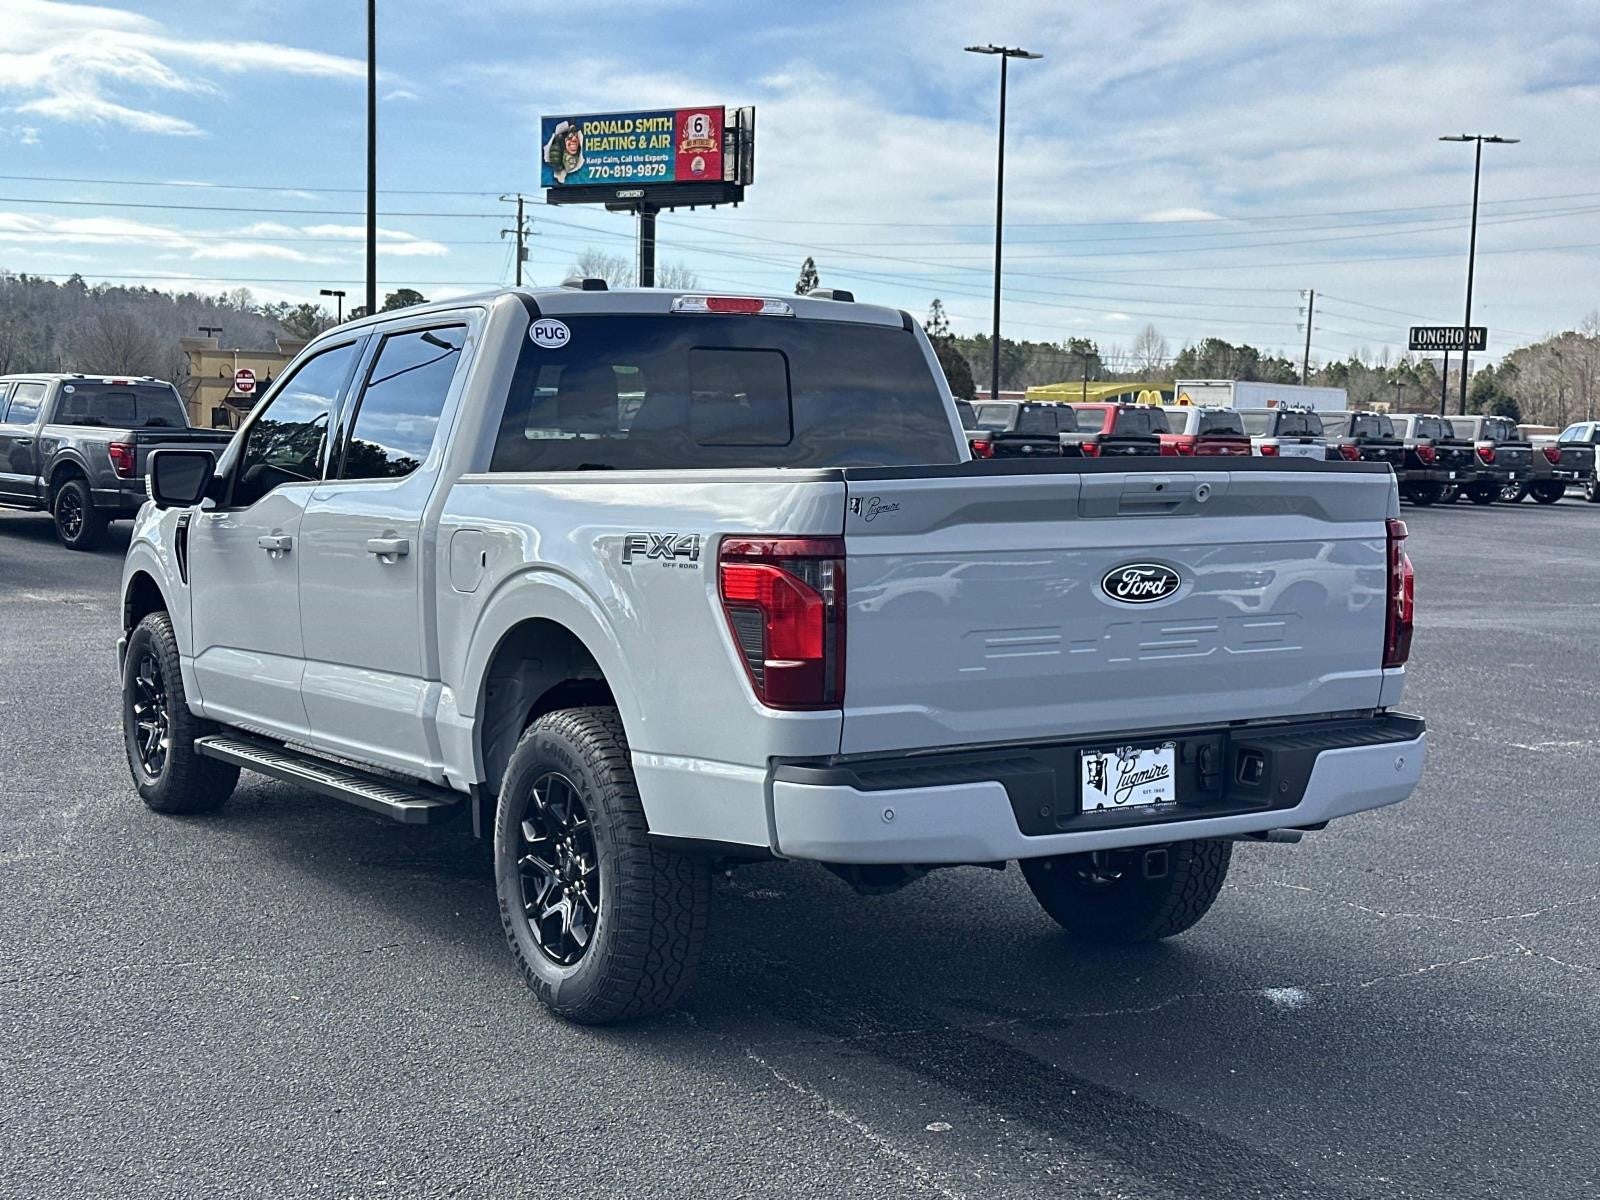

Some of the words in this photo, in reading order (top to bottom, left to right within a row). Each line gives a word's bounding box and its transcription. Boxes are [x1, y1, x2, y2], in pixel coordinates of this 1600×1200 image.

[583, 120, 634, 135] RONALD
[635, 117, 673, 133] SMITH
[694, 117, 703, 133] 6
[585, 136, 636, 151] HEATING
[638, 135, 647, 149] &
[649, 134, 671, 149] AIR
[586, 157, 602, 165] Keep
[603, 155, 620, 163] Calm,
[645, 154, 669, 162] Experts
[588, 163, 667, 179] 770-819-9879
[535, 327, 566, 340] PUG
[1411, 328, 1481, 344] LONGHORN
[622, 532, 700, 565] FX4
[1117, 569, 1167, 595] Ford
[1114, 757, 1170, 805] Pugmire
